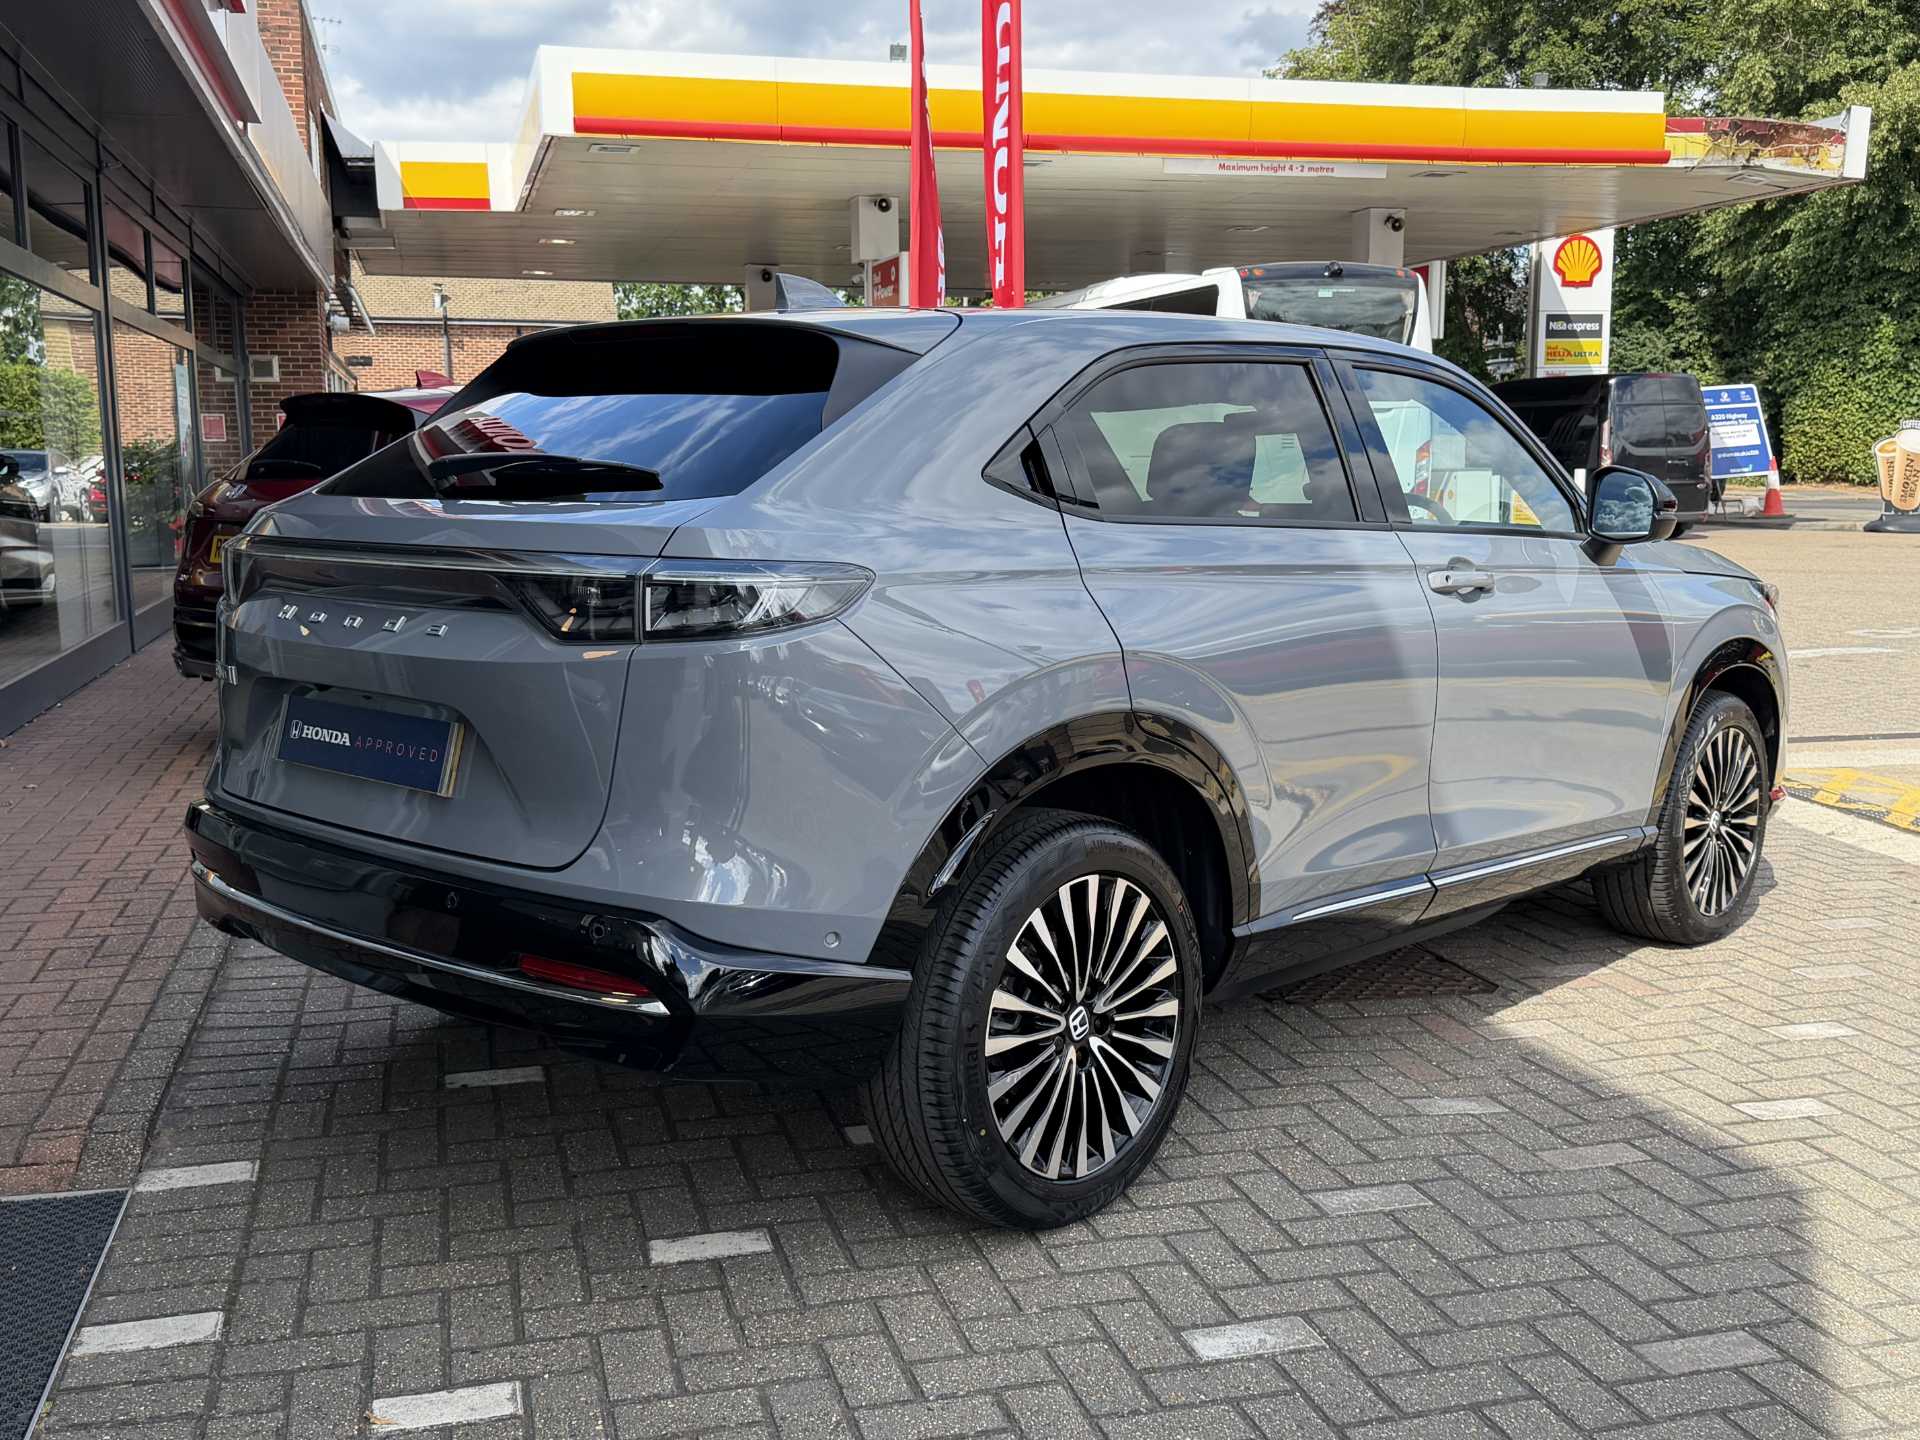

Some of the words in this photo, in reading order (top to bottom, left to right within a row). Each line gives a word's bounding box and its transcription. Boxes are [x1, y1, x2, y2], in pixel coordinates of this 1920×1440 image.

[1218, 162, 1258, 172] Maximum
[1260, 163, 1286, 174] height
[1307, 166, 1335, 174] metres
[1567, 322, 1600, 332] express
[301, 725, 351, 746] HONDA
[354, 736, 439, 763] APPROVED
